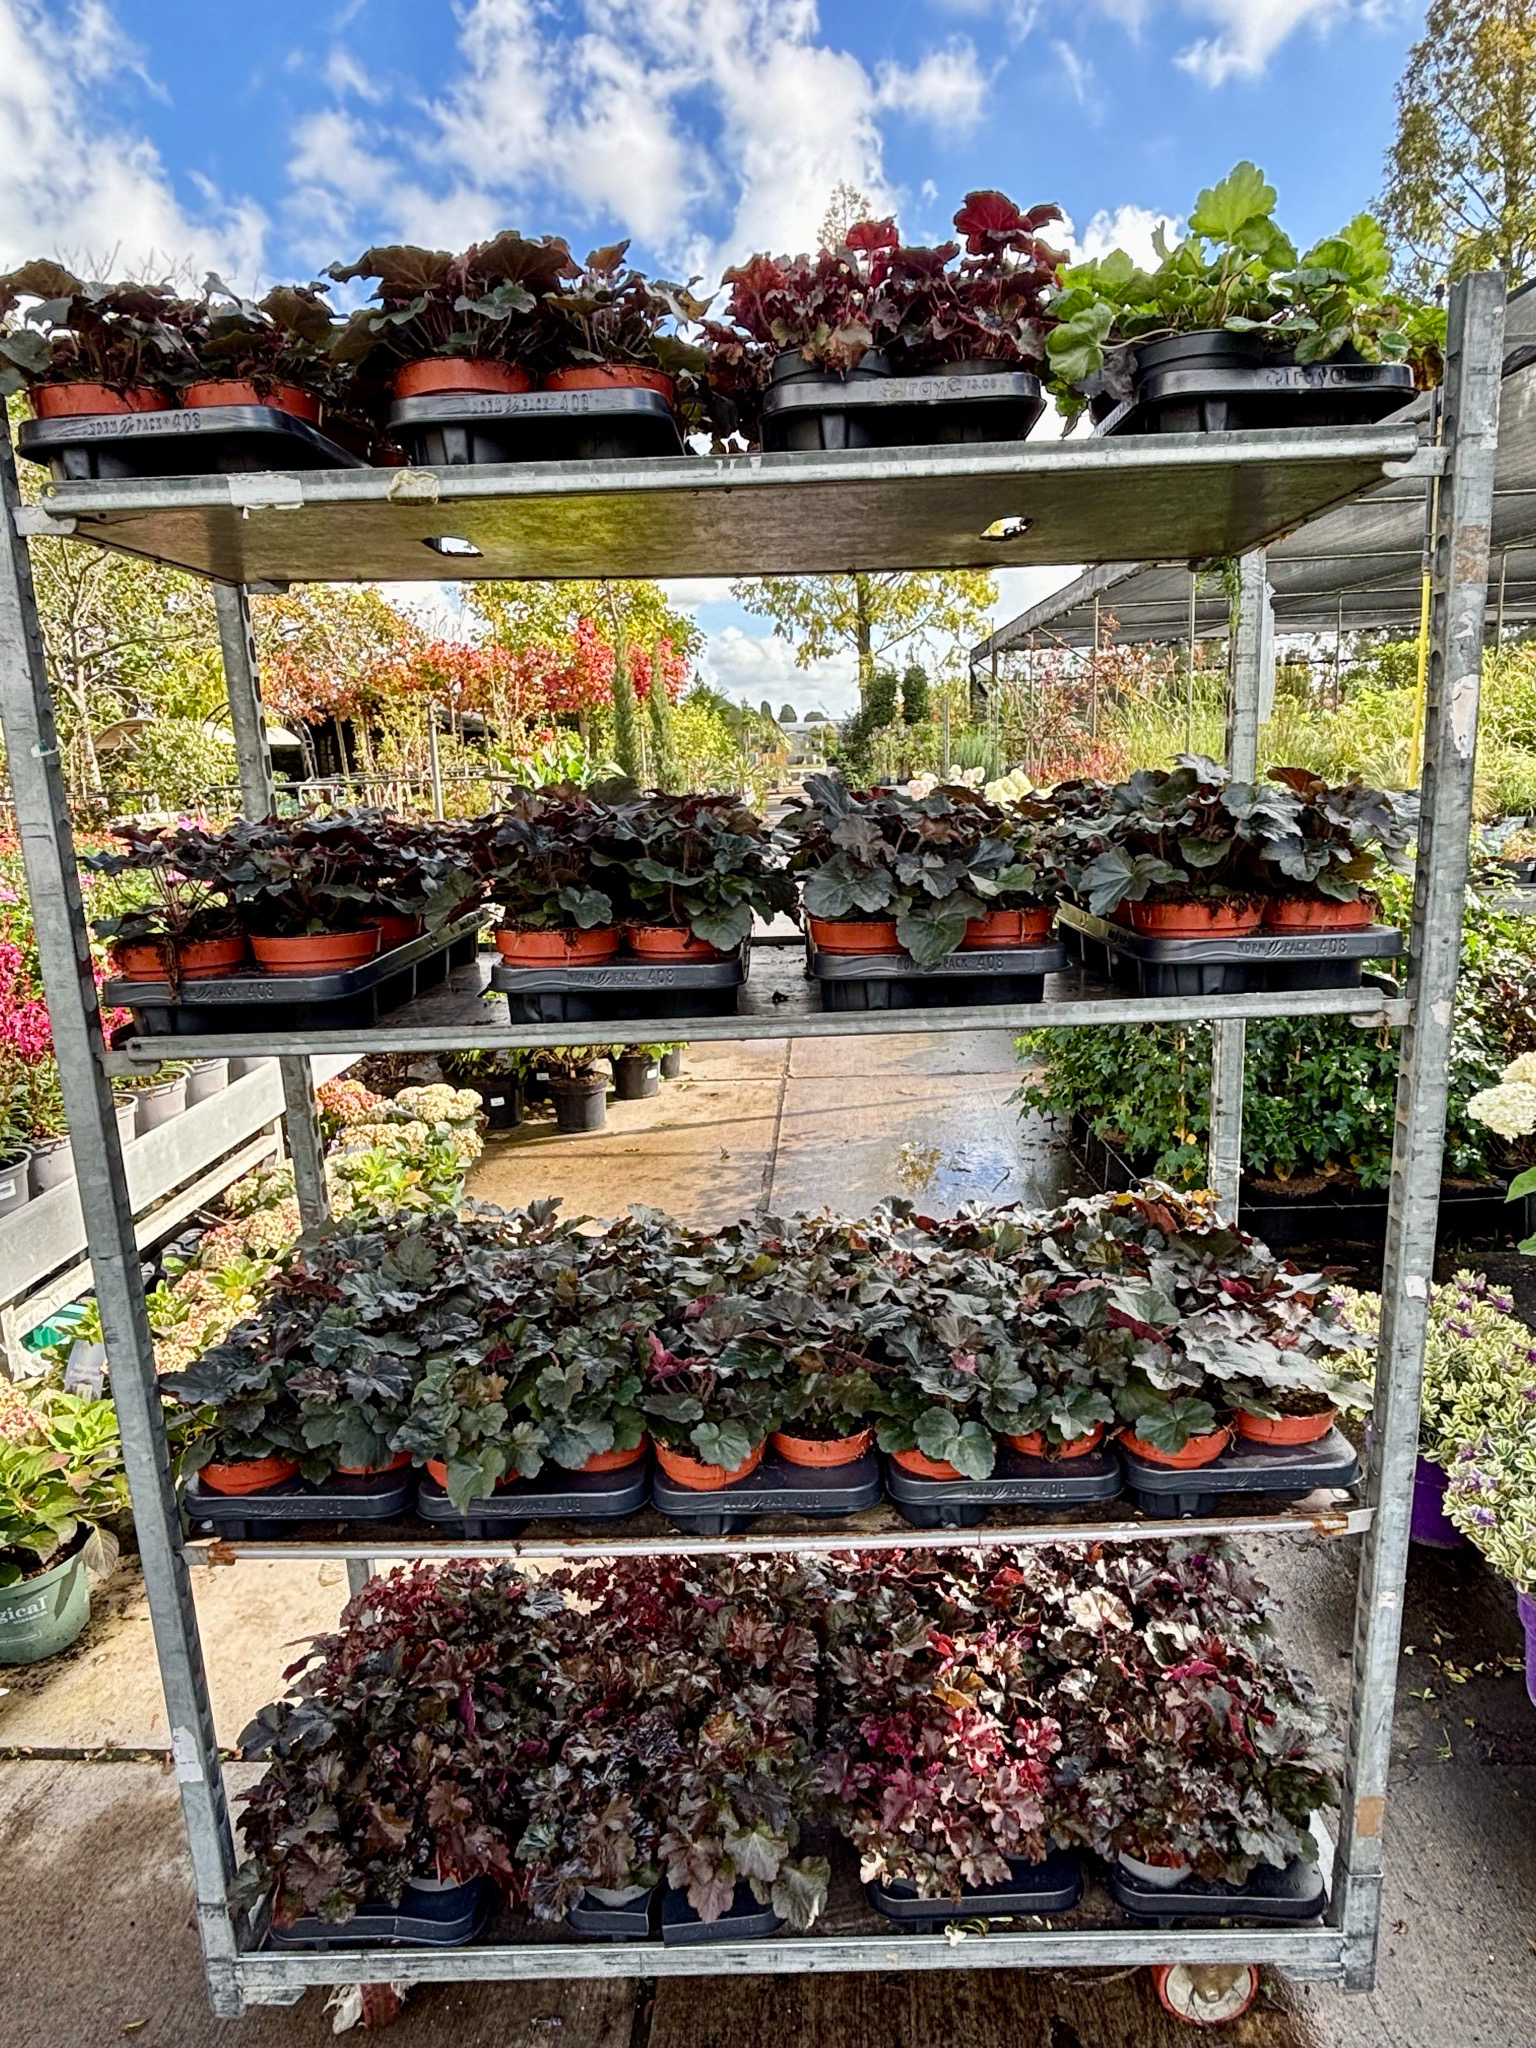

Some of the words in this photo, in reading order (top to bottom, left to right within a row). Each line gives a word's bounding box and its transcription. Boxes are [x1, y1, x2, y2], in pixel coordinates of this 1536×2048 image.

[1319, 937, 1348, 956] 408
[977, 955, 1005, 972] 408
[647, 968, 675, 986] 408
